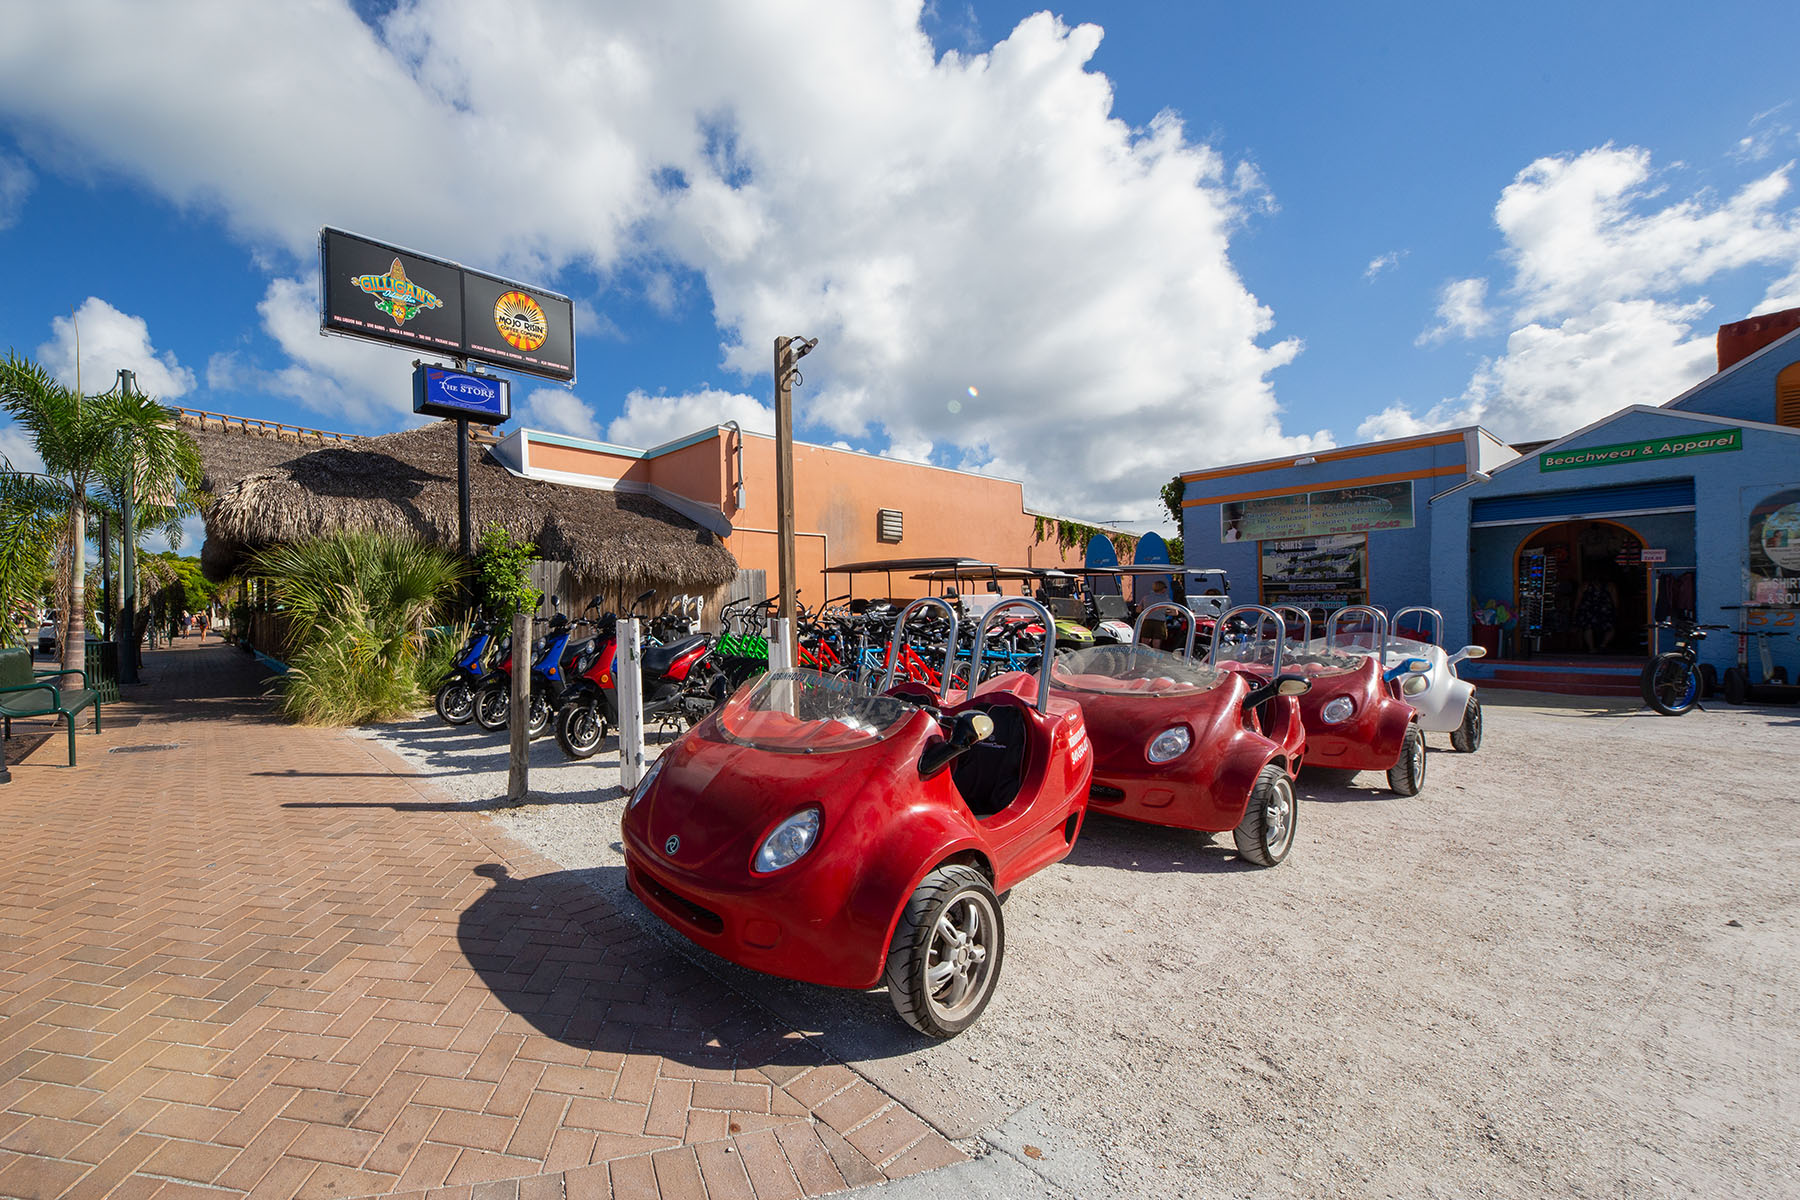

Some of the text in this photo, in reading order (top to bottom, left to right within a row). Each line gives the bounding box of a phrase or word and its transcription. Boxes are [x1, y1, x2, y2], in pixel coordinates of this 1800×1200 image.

[360, 276, 435, 308] GILLIGAN'S
[499, 315, 521, 328] MOJO
[500, 324, 519, 334] COFFEE
[520, 329, 543, 340] COMPANY
[460, 386, 495, 398] STORE
[1545, 434, 1734, 466] Beachwear & Apparel
[1768, 593, 1775, 605] &
